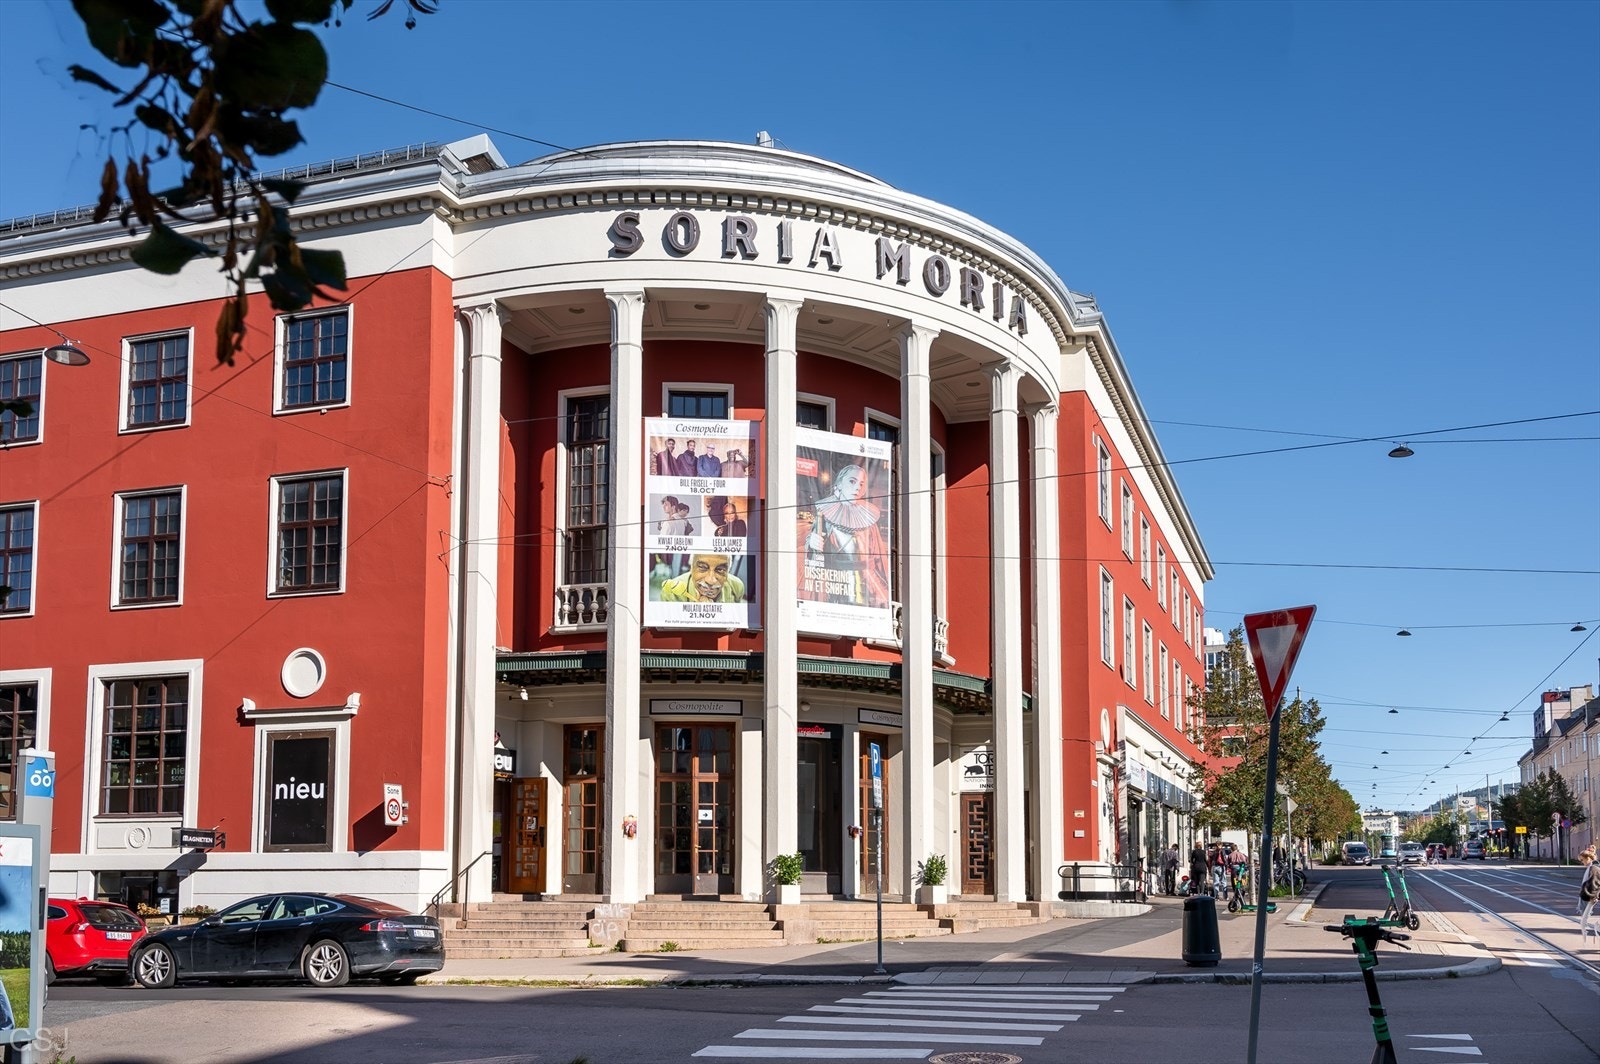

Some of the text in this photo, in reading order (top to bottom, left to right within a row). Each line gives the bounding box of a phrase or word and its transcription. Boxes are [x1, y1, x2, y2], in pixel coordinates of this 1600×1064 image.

[609, 210, 1028, 336] SORIA MORIA
[675, 423, 729, 435] Cosmopolite
[679, 478, 690, 487] BILL
[690, 478, 709, 488] FRISELL
[714, 480, 726, 488] FOUR
[712, 538, 742, 548] LEELA JAMES
[815, 580, 824, 593] ET
[668, 702, 724, 712] Cosmopolite
[494, 754, 513, 772] eu
[872, 748, 878, 773] P
[171, 765, 185, 775] nie
[275, 776, 325, 800] nieu
[387, 786, 400, 794] Sone
[390, 804, 398, 816] 30
